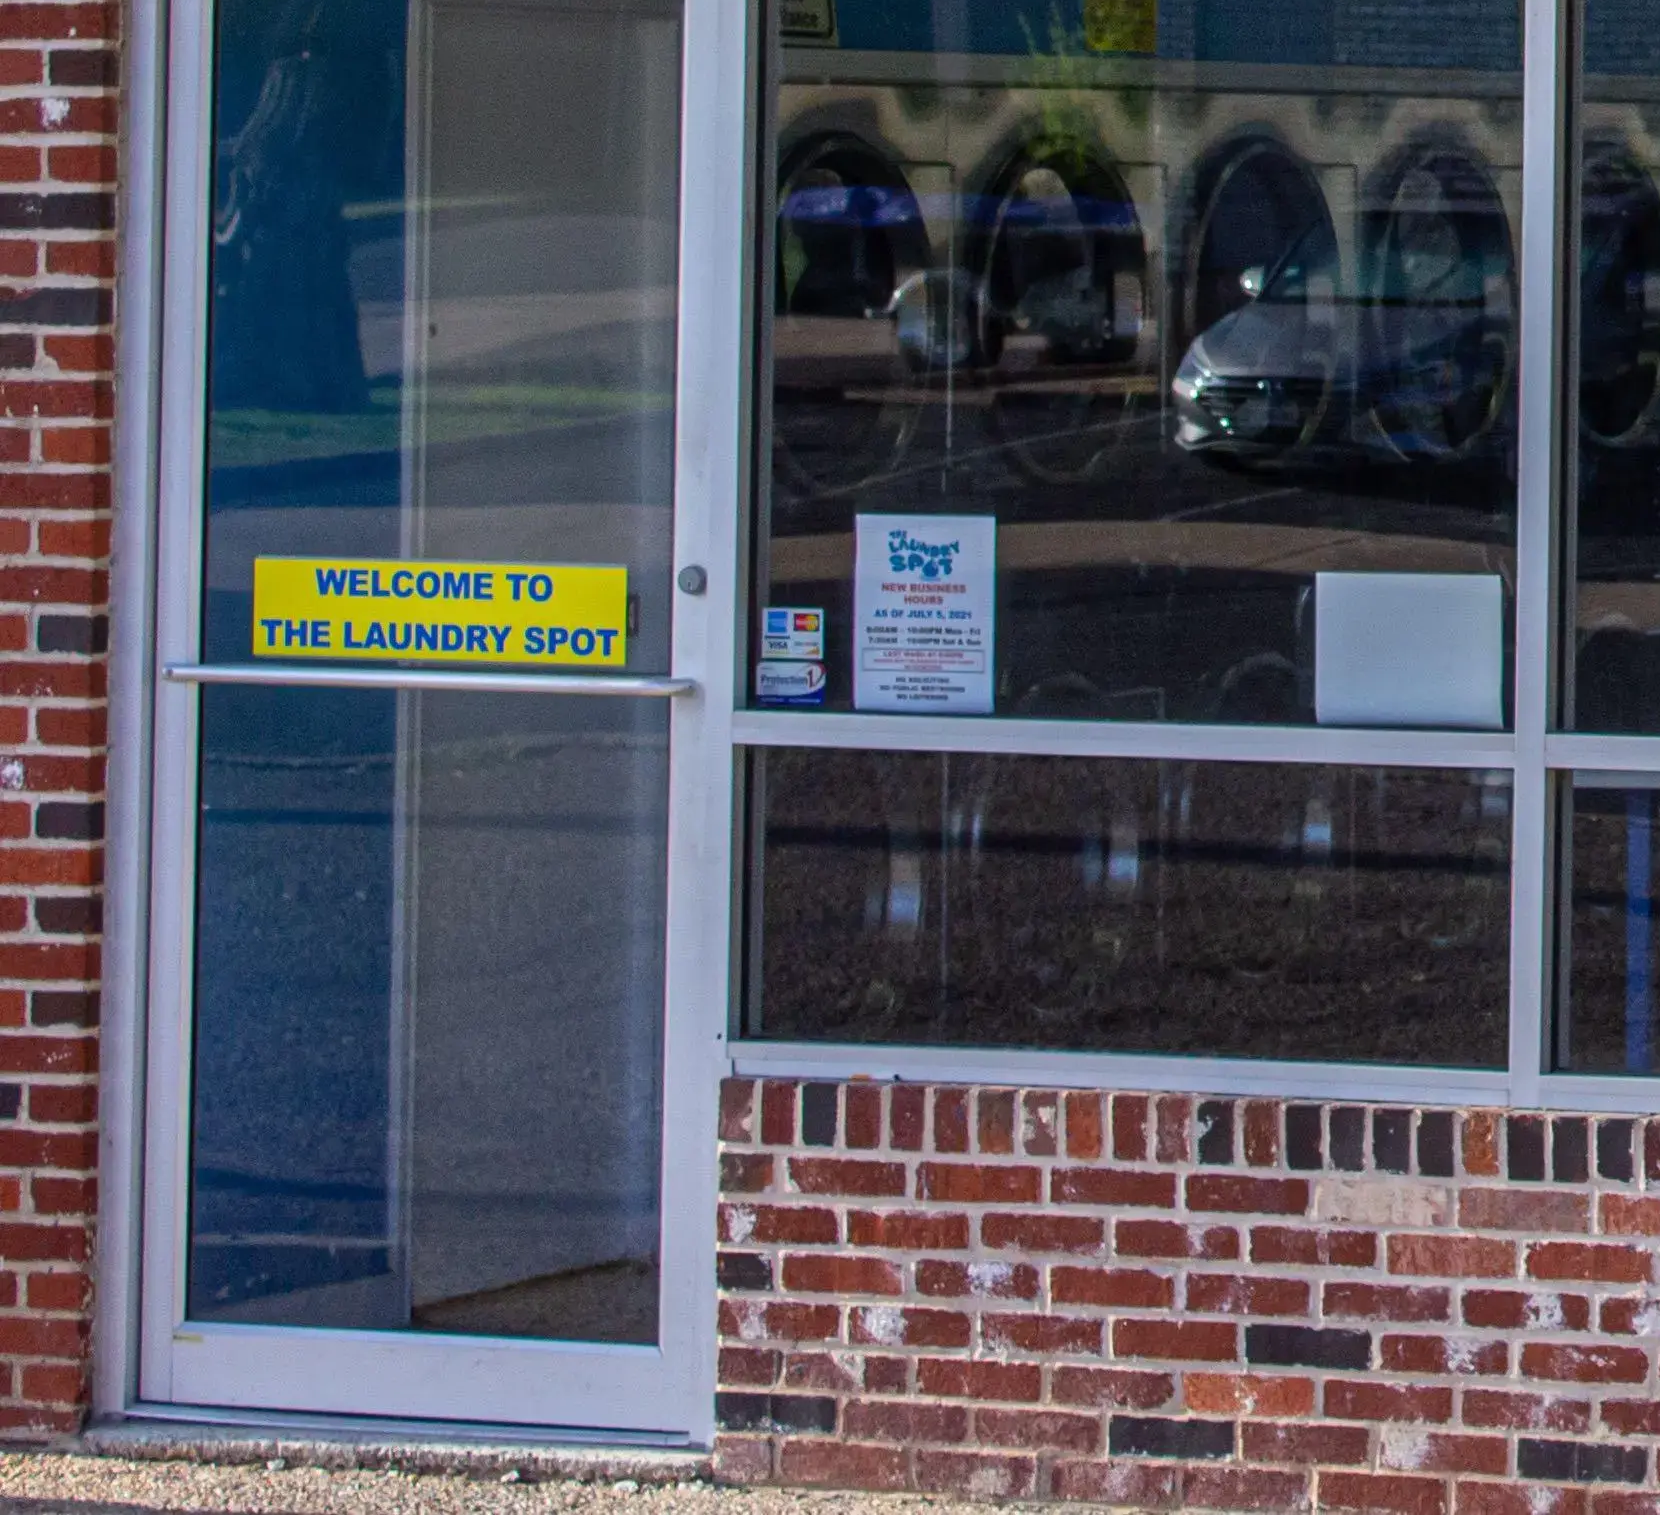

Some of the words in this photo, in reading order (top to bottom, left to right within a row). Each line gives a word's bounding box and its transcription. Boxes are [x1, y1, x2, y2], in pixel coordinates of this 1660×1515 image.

[888, 538, 960, 558] LAUNDRY
[315, 567, 495, 601] WELCOME
[505, 572, 554, 602] TO
[910, 583, 967, 594] BUSINESS
[904, 595, 944, 605] HOURS
[907, 610, 933, 619] JULY
[260, 618, 331, 648] THE
[343, 621, 512, 654] LAUNDRY
[523, 626, 619, 657] SPOT
